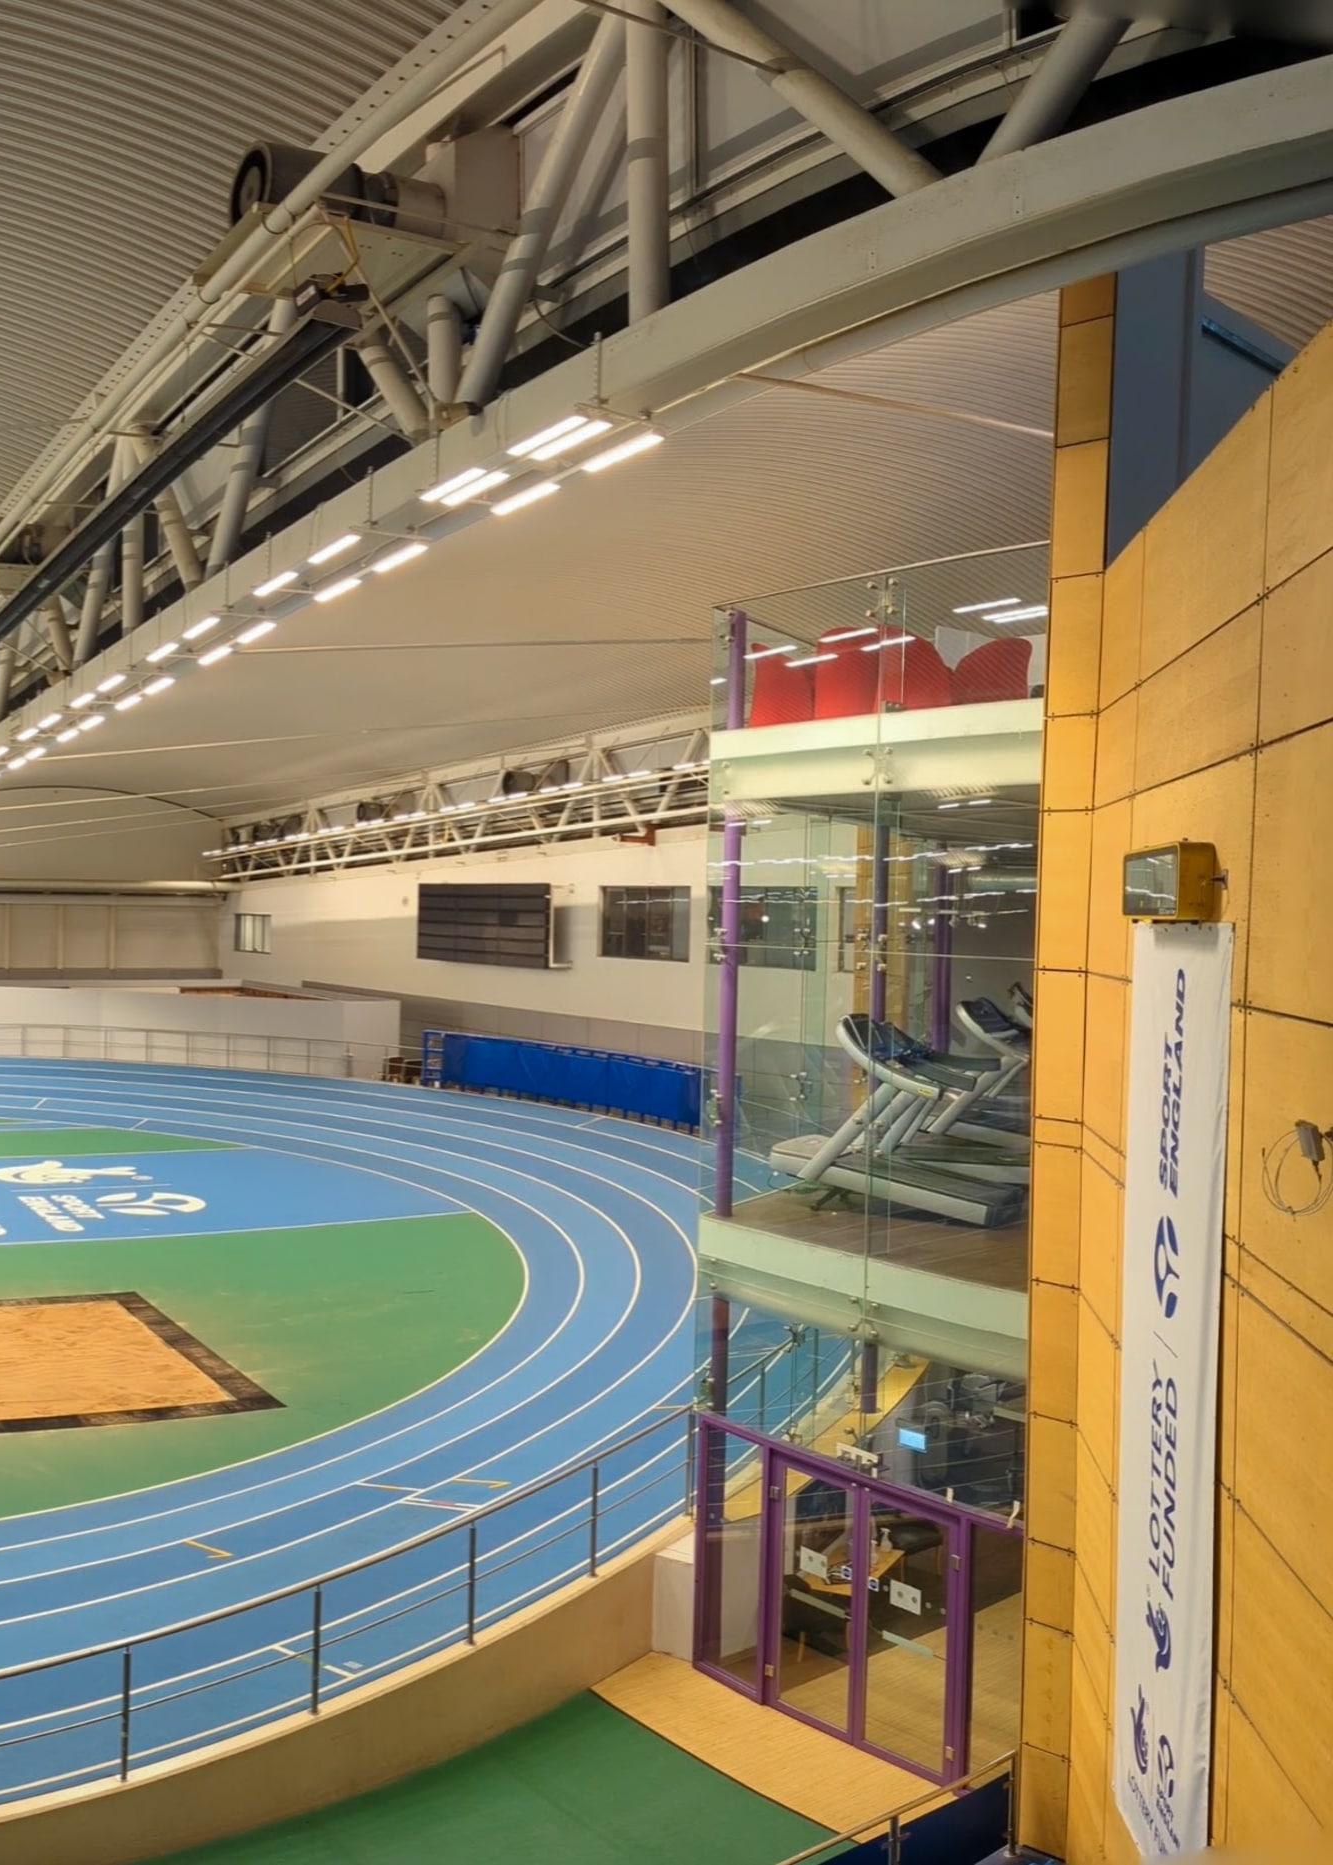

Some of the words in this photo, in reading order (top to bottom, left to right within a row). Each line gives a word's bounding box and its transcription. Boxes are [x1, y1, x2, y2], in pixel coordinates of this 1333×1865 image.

[1159, 1032, 1173, 1191] SPORT
[1169, 968, 1186, 1198] ENGLAND
[17, 1196, 85, 1232] ENGLAND
[50, 1194, 105, 1219] SPORT
[1149, 1358, 1162, 1577] LOTTERY
[1162, 1377, 1177, 1601] FUNDED
